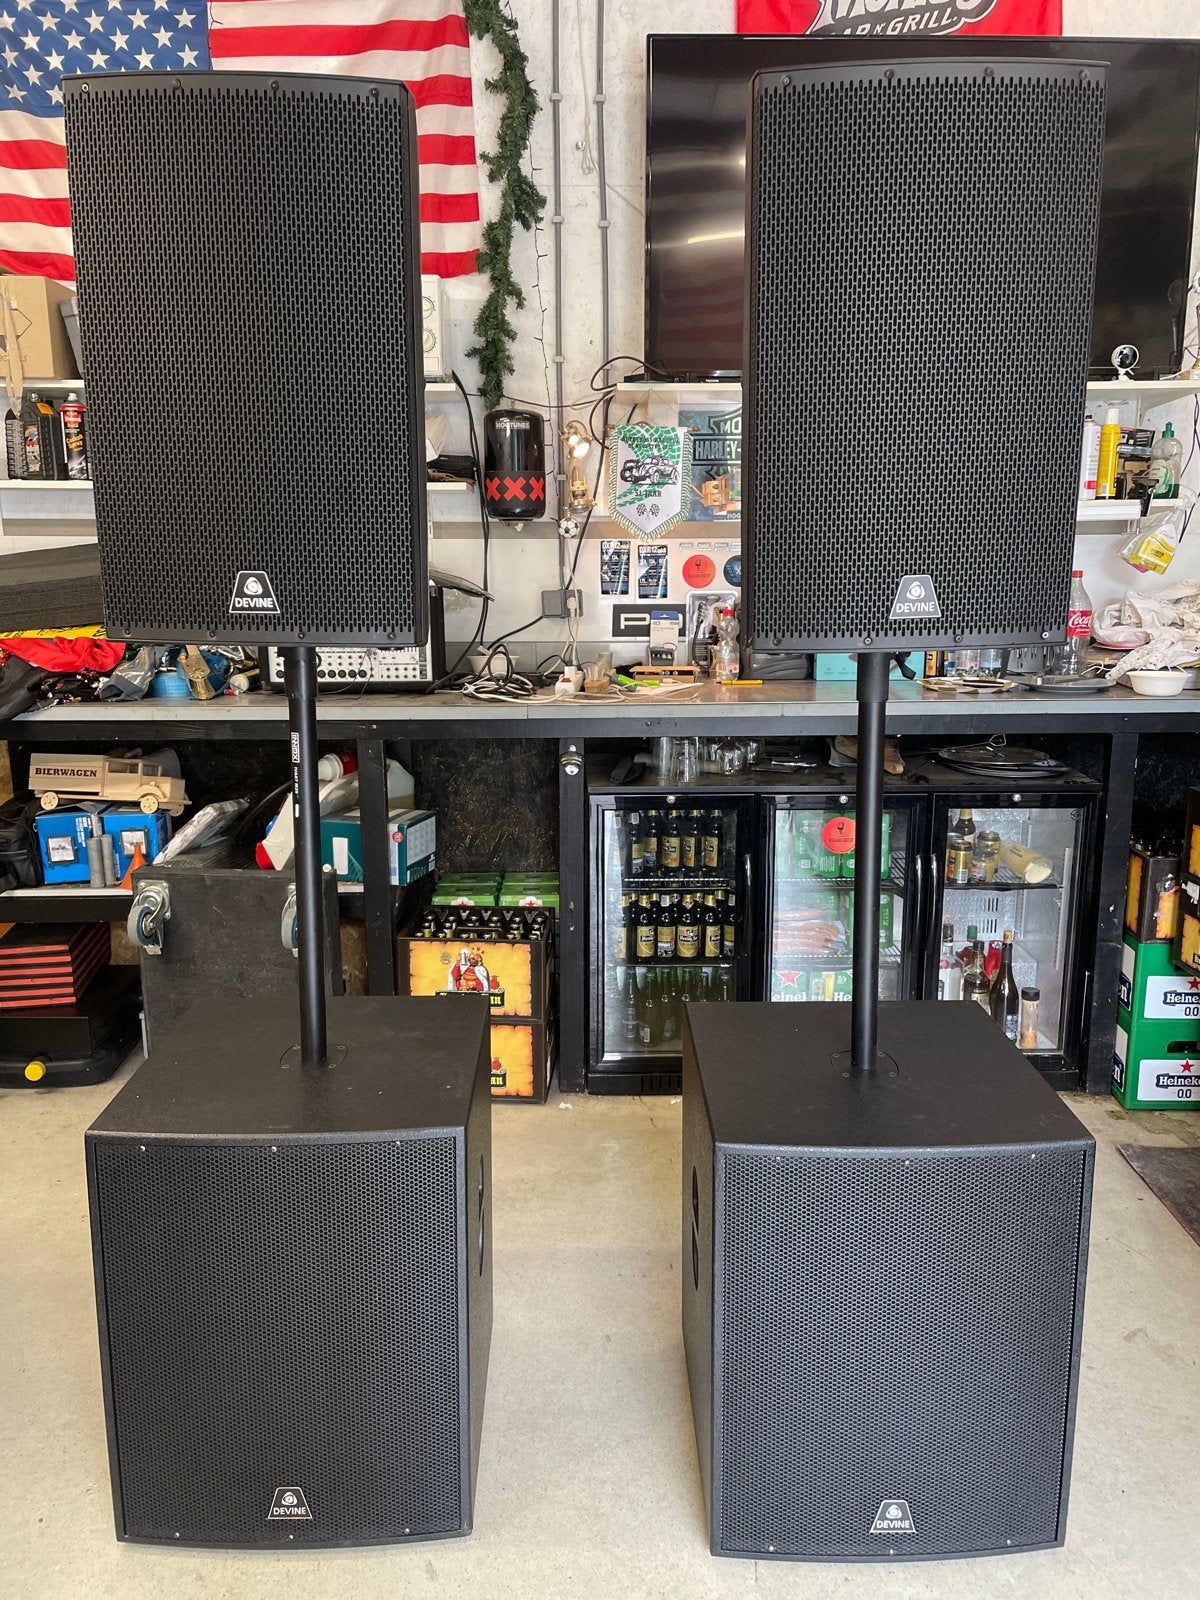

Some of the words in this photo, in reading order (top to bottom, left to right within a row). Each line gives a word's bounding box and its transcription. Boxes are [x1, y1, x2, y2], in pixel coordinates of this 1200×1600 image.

[235, 598, 273, 607] DEVINE
[896, 602, 935, 613] DEVINE
[35, 768, 97, 777] BIERWAGEN
[1166, 993, 1200, 1003] Heine
[273, 1507, 306, 1515] DEVINE
[876, 1520, 910, 1528] DEVINE
